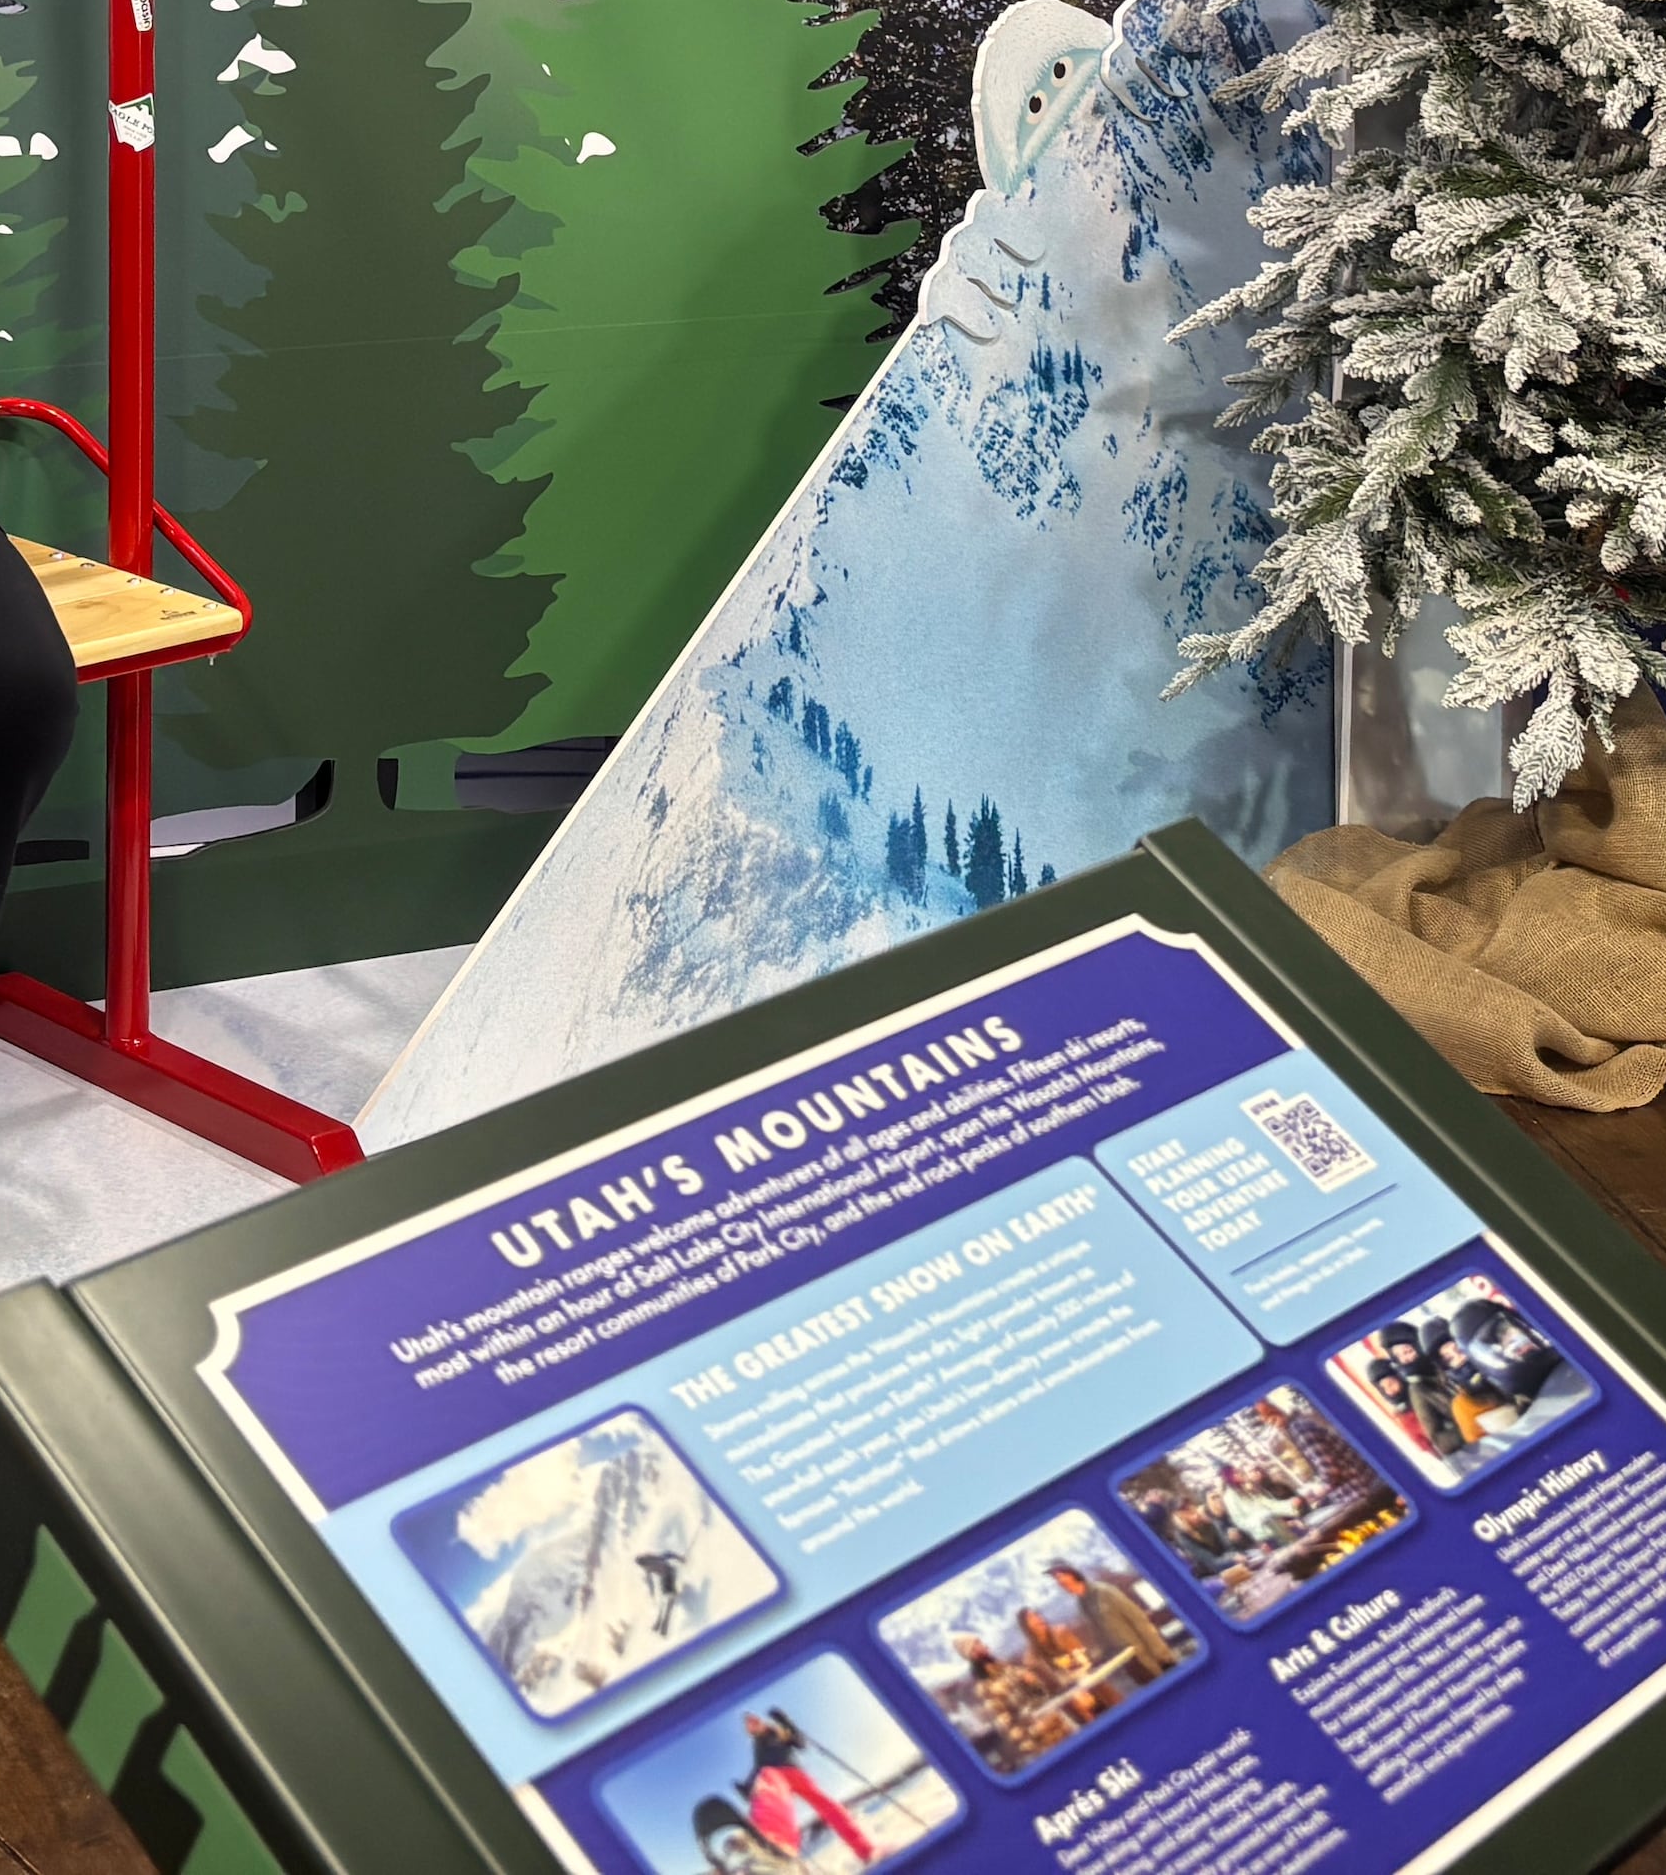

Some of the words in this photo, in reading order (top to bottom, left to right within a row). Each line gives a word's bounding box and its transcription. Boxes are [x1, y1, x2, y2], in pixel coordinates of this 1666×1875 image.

[464, 1279, 564, 1333] mountain
[562, 1248, 634, 1288] ranges
[631, 1221, 717, 1255] welcome
[716, 1161, 824, 1218] adventurers
[822, 1147, 843, 1170] of
[843, 1137, 868, 1160] all
[867, 1121, 912, 1150] ages
[910, 1102, 947, 1130] and
[1007, 1052, 1067, 1083] Fifteen
[1065, 1040, 1090, 1060] ski
[490, 1154, 704, 1269] UTAH'S
[715, 1016, 1023, 1173] MOUNTAINS
[1128, 1138, 1187, 1177] START
[1144, 1137, 1247, 1196] PLANNING
[1162, 1176, 1221, 1213] YOUR
[1220, 1151, 1271, 1187] UTAH
[415, 1350, 472, 1388] most
[470, 1324, 536, 1362] within
[536, 1310, 567, 1333] an
[560, 1288, 613, 1319] hour
[614, 1273, 637, 1297] of
[632, 1256, 677, 1287] Salt
[671, 1238, 725, 1268] Lake
[721, 1220, 763, 1245] City
[758, 1163, 877, 1228] International
[941, 1118, 985, 1147] span
[980, 1105, 1012, 1126] the
[1007, 1073, 1080, 1111] Wasatch
[495, 1358, 535, 1384] the
[534, 1326, 596, 1367] resort
[596, 1273, 718, 1339] communities
[716, 1257, 738, 1282] of
[733, 1240, 784, 1271] Park
[823, 1200, 863, 1231] and
[858, 1191, 892, 1213] the
[890, 1172, 924, 1199] red
[922, 1157, 961, 1185] rock
[958, 1135, 1011, 1171] peaks
[1009, 1122, 1029, 1144] of
[1027, 1096, 1097, 1135] southern
[1182, 1169, 1290, 1234] ADVENTURE
[1196, 1209, 1263, 1252] TODAY
[670, 1363, 737, 1411] THE
[733, 1296, 874, 1382] GREATEST
[870, 1251, 964, 1314] SNOW
[962, 1227, 1015, 1267] ON
[1473, 1487, 1544, 1543] Olympic
[1538, 1450, 1608, 1500] History
[1269, 1644, 1318, 1685] Arts
[1310, 1629, 1339, 1655] &
[1329, 1589, 1402, 1641] Culture
[1096, 1757, 1144, 1800] Ski
